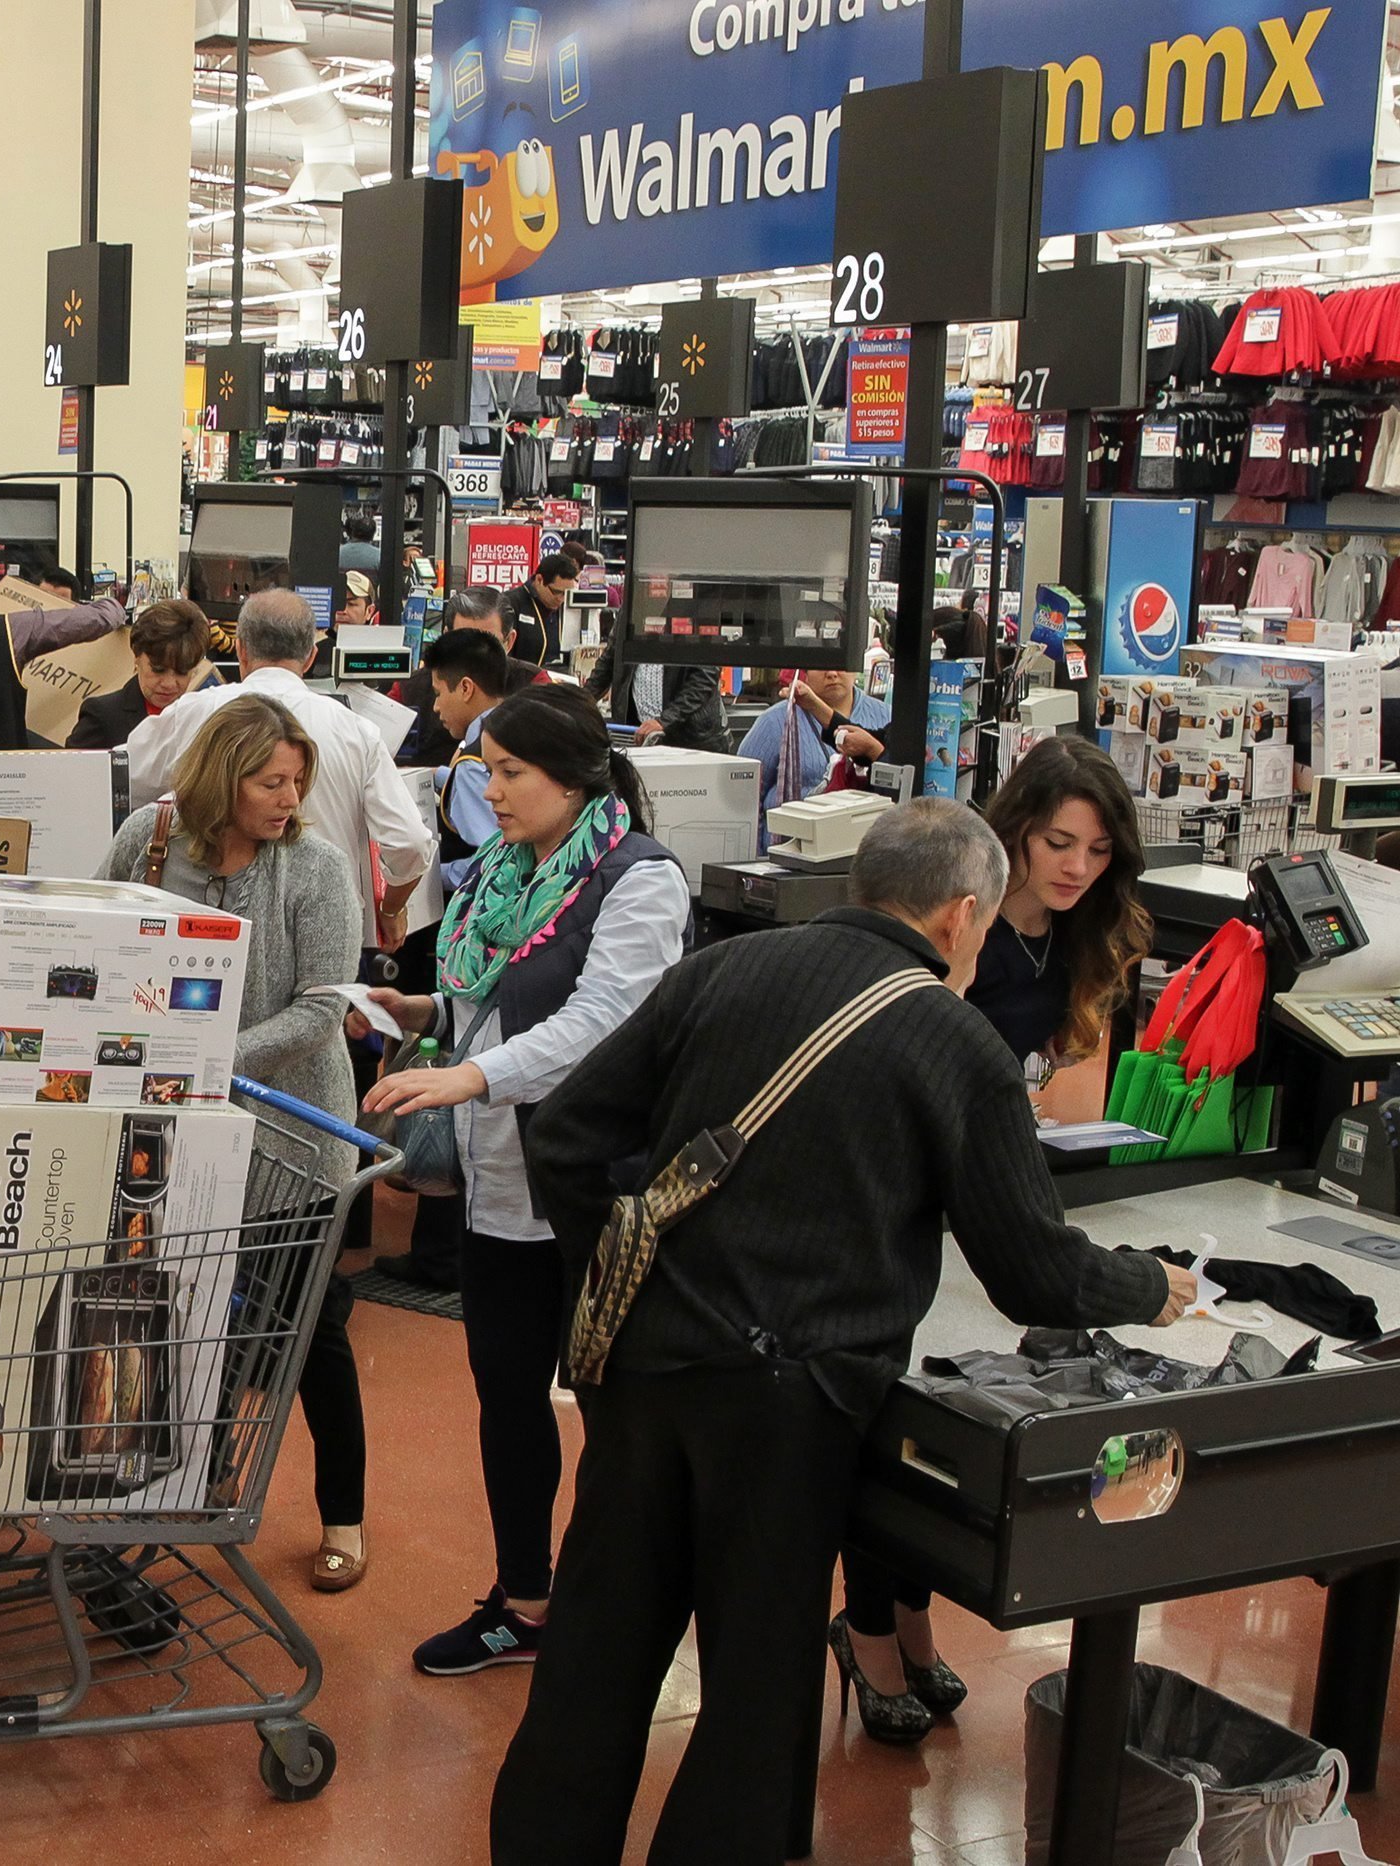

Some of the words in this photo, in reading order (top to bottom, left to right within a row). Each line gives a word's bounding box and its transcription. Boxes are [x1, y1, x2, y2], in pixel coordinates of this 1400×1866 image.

[689, 0, 864, 56] Compra
[579, 77, 864, 226] Walmar
[833, 252, 885, 324] 28
[338, 308, 365, 362] 26
[859, 342, 892, 352] Walmart
[45, 344, 62, 385] 24
[852, 361, 874, 370] Retira
[875, 360, 906, 369] efectivo
[864, 375, 891, 391] SIN
[1017, 367, 1050, 411] 27
[658, 382, 680, 416] 25
[851, 391, 905, 403] COMISIÓN
[205, 404, 217, 430] 21
[406, 395, 414, 424] 3
[867, 409, 899, 418] compras
[856, 419, 893, 428] superiores
[858, 428, 871, 437] $15
[873, 429, 894, 438] pesos
[472, 552, 529, 560] REFRESCANTE
[475, 544, 526, 553] DELICIOSA
[471, 565, 529, 583] BIEN
[0, 587, 43, 608] SAMSUN
[1261, 664, 1313, 683] ROWA
[72, 677, 102, 699] TV
[649, 790, 659, 798] DE
[660, 789, 708, 799] MICROONDAS
[141, 920, 166, 929] 2200W
[194, 924, 234, 933] KAISER
[36, 1147, 68, 1250] Countertop
[53, 1201, 76, 1248] Oven
